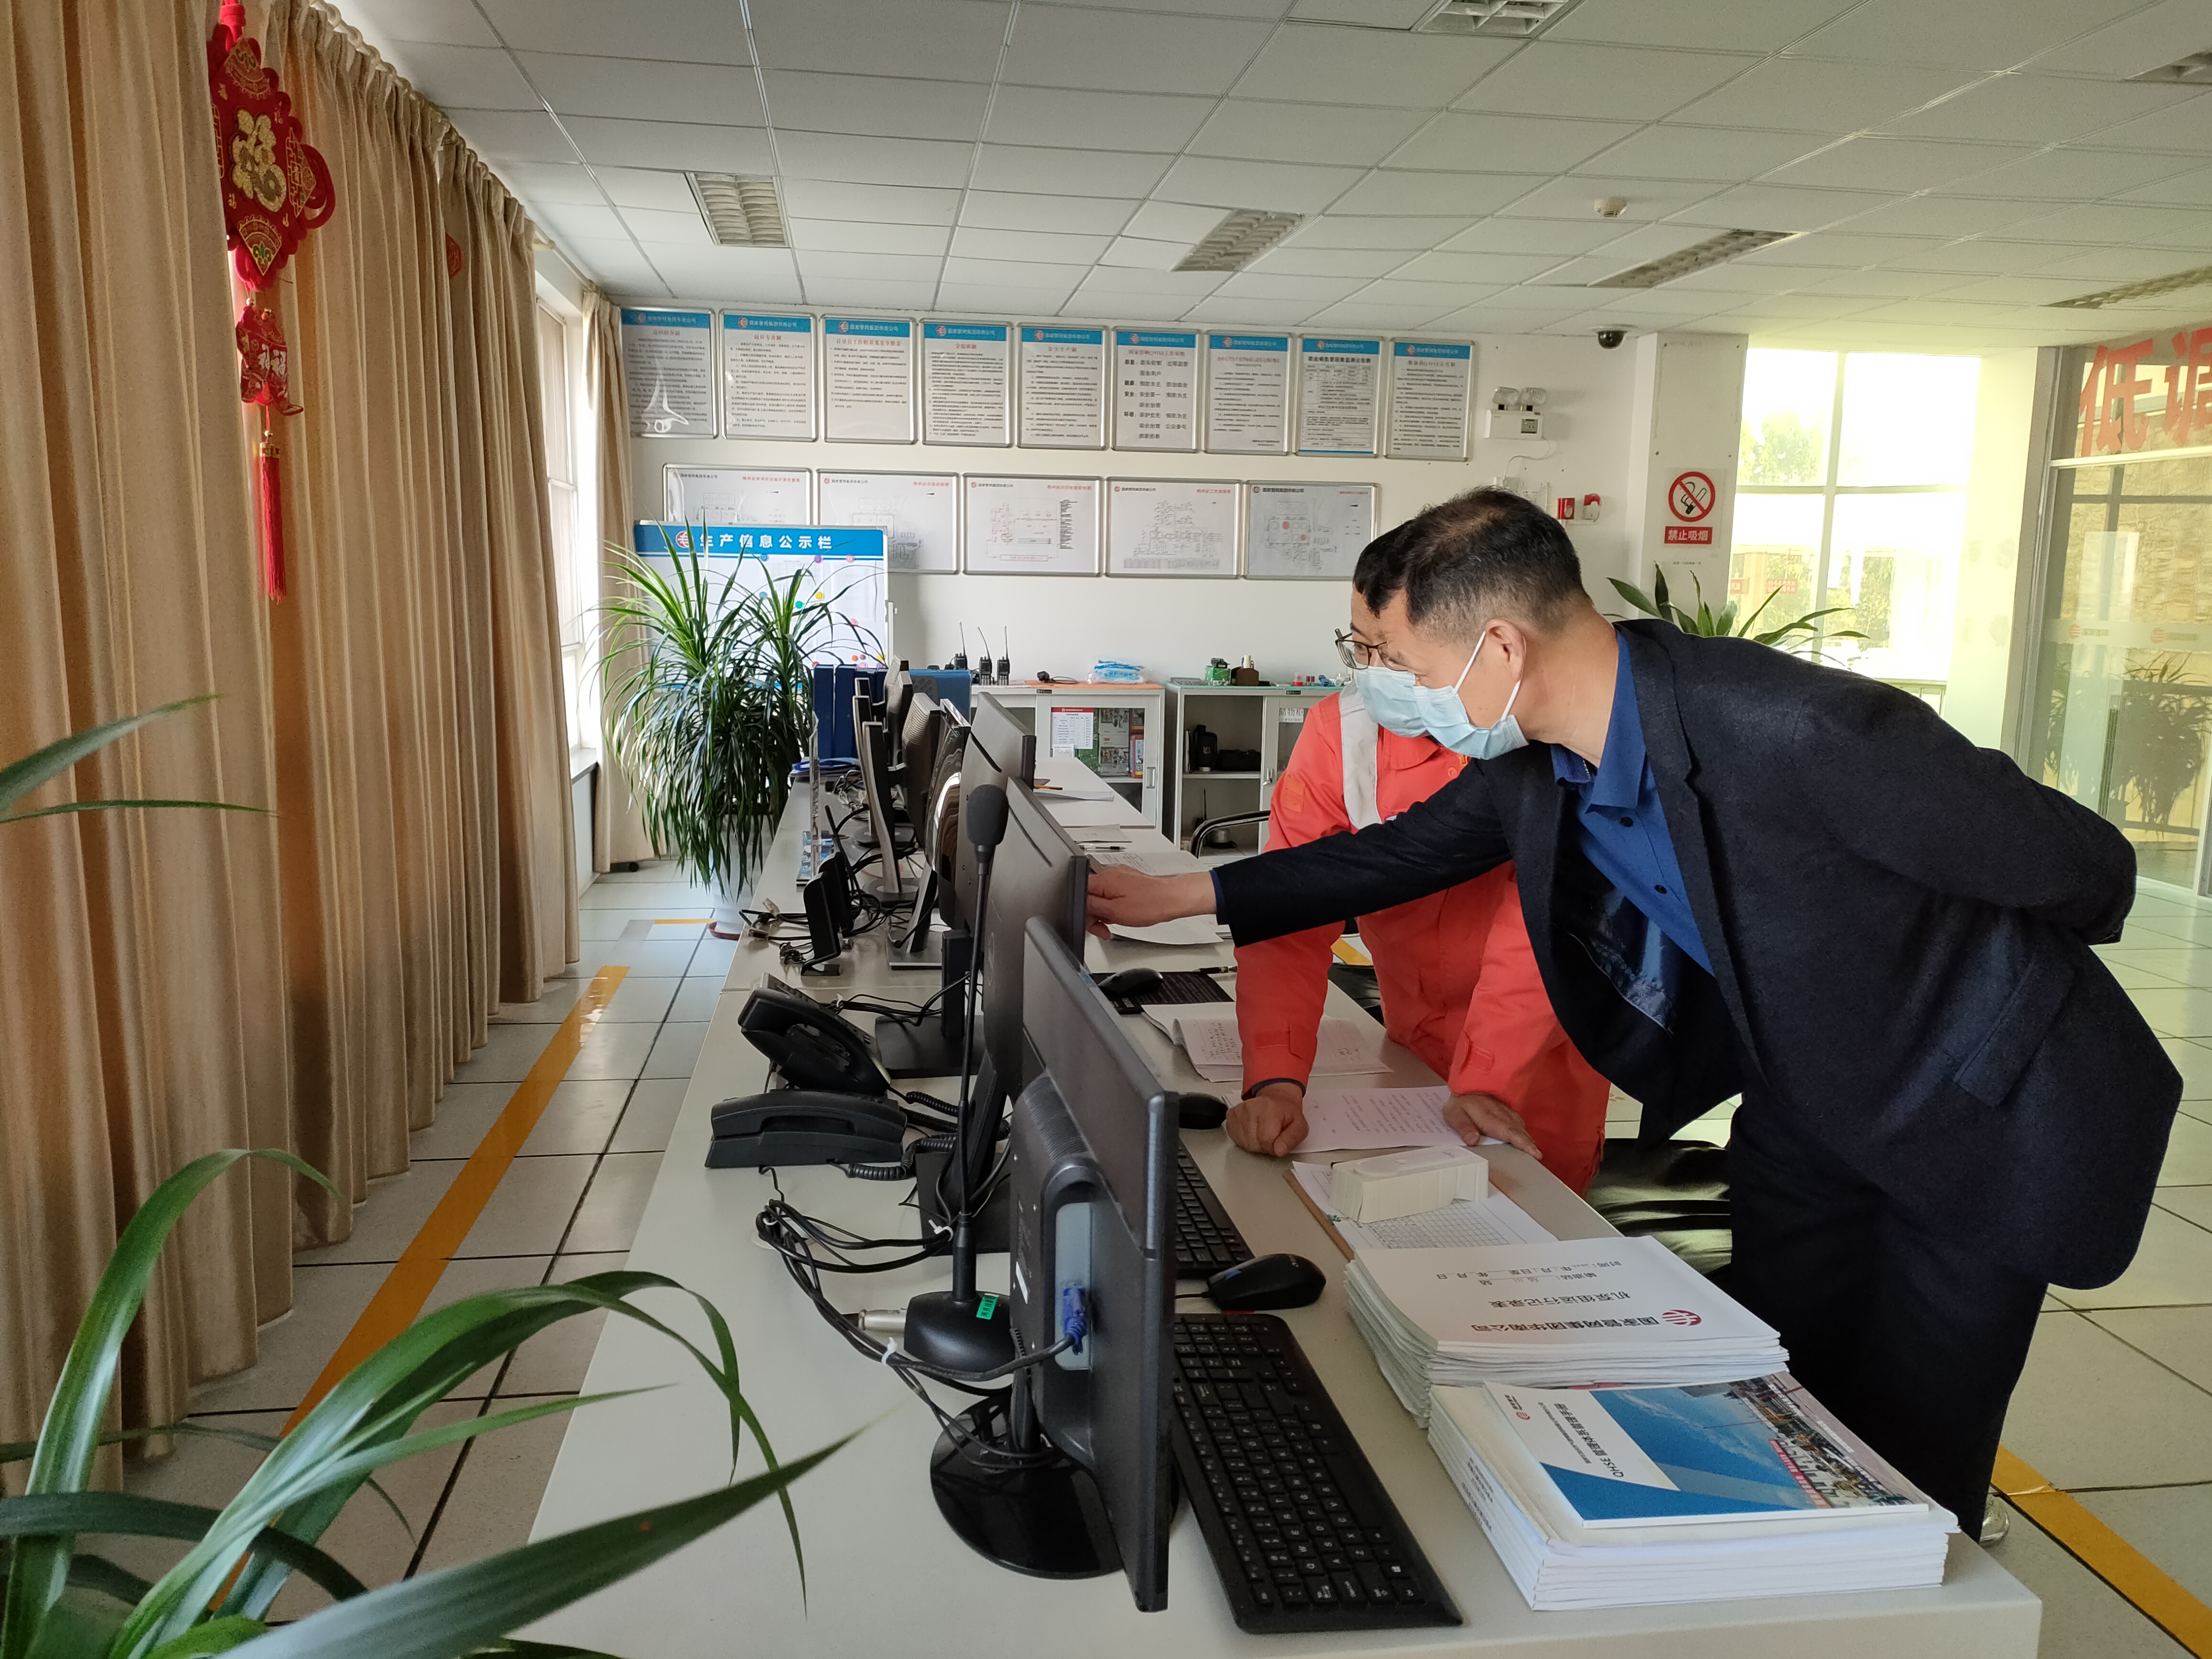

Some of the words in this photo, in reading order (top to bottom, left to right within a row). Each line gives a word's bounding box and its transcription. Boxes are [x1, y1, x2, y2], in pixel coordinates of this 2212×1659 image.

[232, 108, 287, 212] 福
[699, 532, 833, 550] 生产信息公示栏
[1668, 529, 1709, 541] 禁止吸烟
[1488, 1290, 1630, 1309] 机泵组运行记录表
[1471, 1316, 1659, 1332] 国家管网集团华南公司
[1554, 1403, 1608, 1456] 管理体系管理手册
[1600, 1457, 1625, 1478] QHSE
